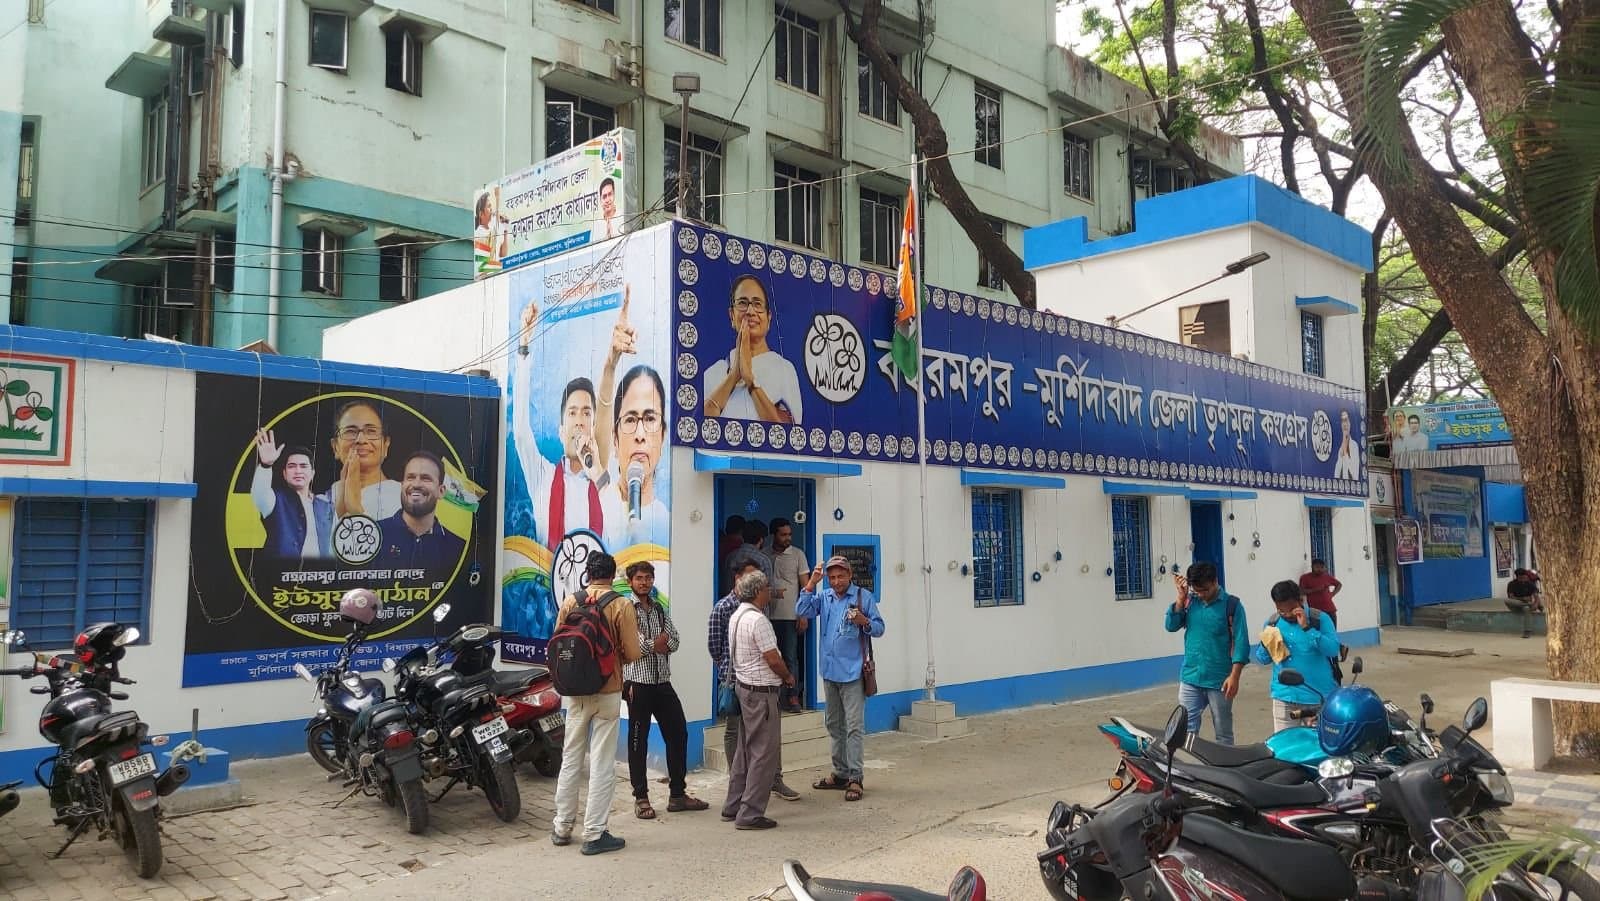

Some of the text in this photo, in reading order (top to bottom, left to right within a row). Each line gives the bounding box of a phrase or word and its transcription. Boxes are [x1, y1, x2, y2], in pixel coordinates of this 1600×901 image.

[570, 168, 589, 186] জেলা
[511, 215, 533, 245] তৃণমূল
[536, 204, 562, 228] কংগ্রেস
[873, 339, 1014, 422] বরমপুর
[1150, 389, 1198, 435] জেলা
[1202, 391, 1256, 455] তৃণমূল
[1258, 408, 1308, 449] কংগ্রেস
[281, 571, 336, 584] বহরমপুর
[338, 569, 392, 581] লোকসভা
[291, 612, 320, 626] জোড়া
[396, 605, 415, 619] দিন
[291, 649, 329, 659] সরকার
[504, 642, 536, 658] বহরমপুর
